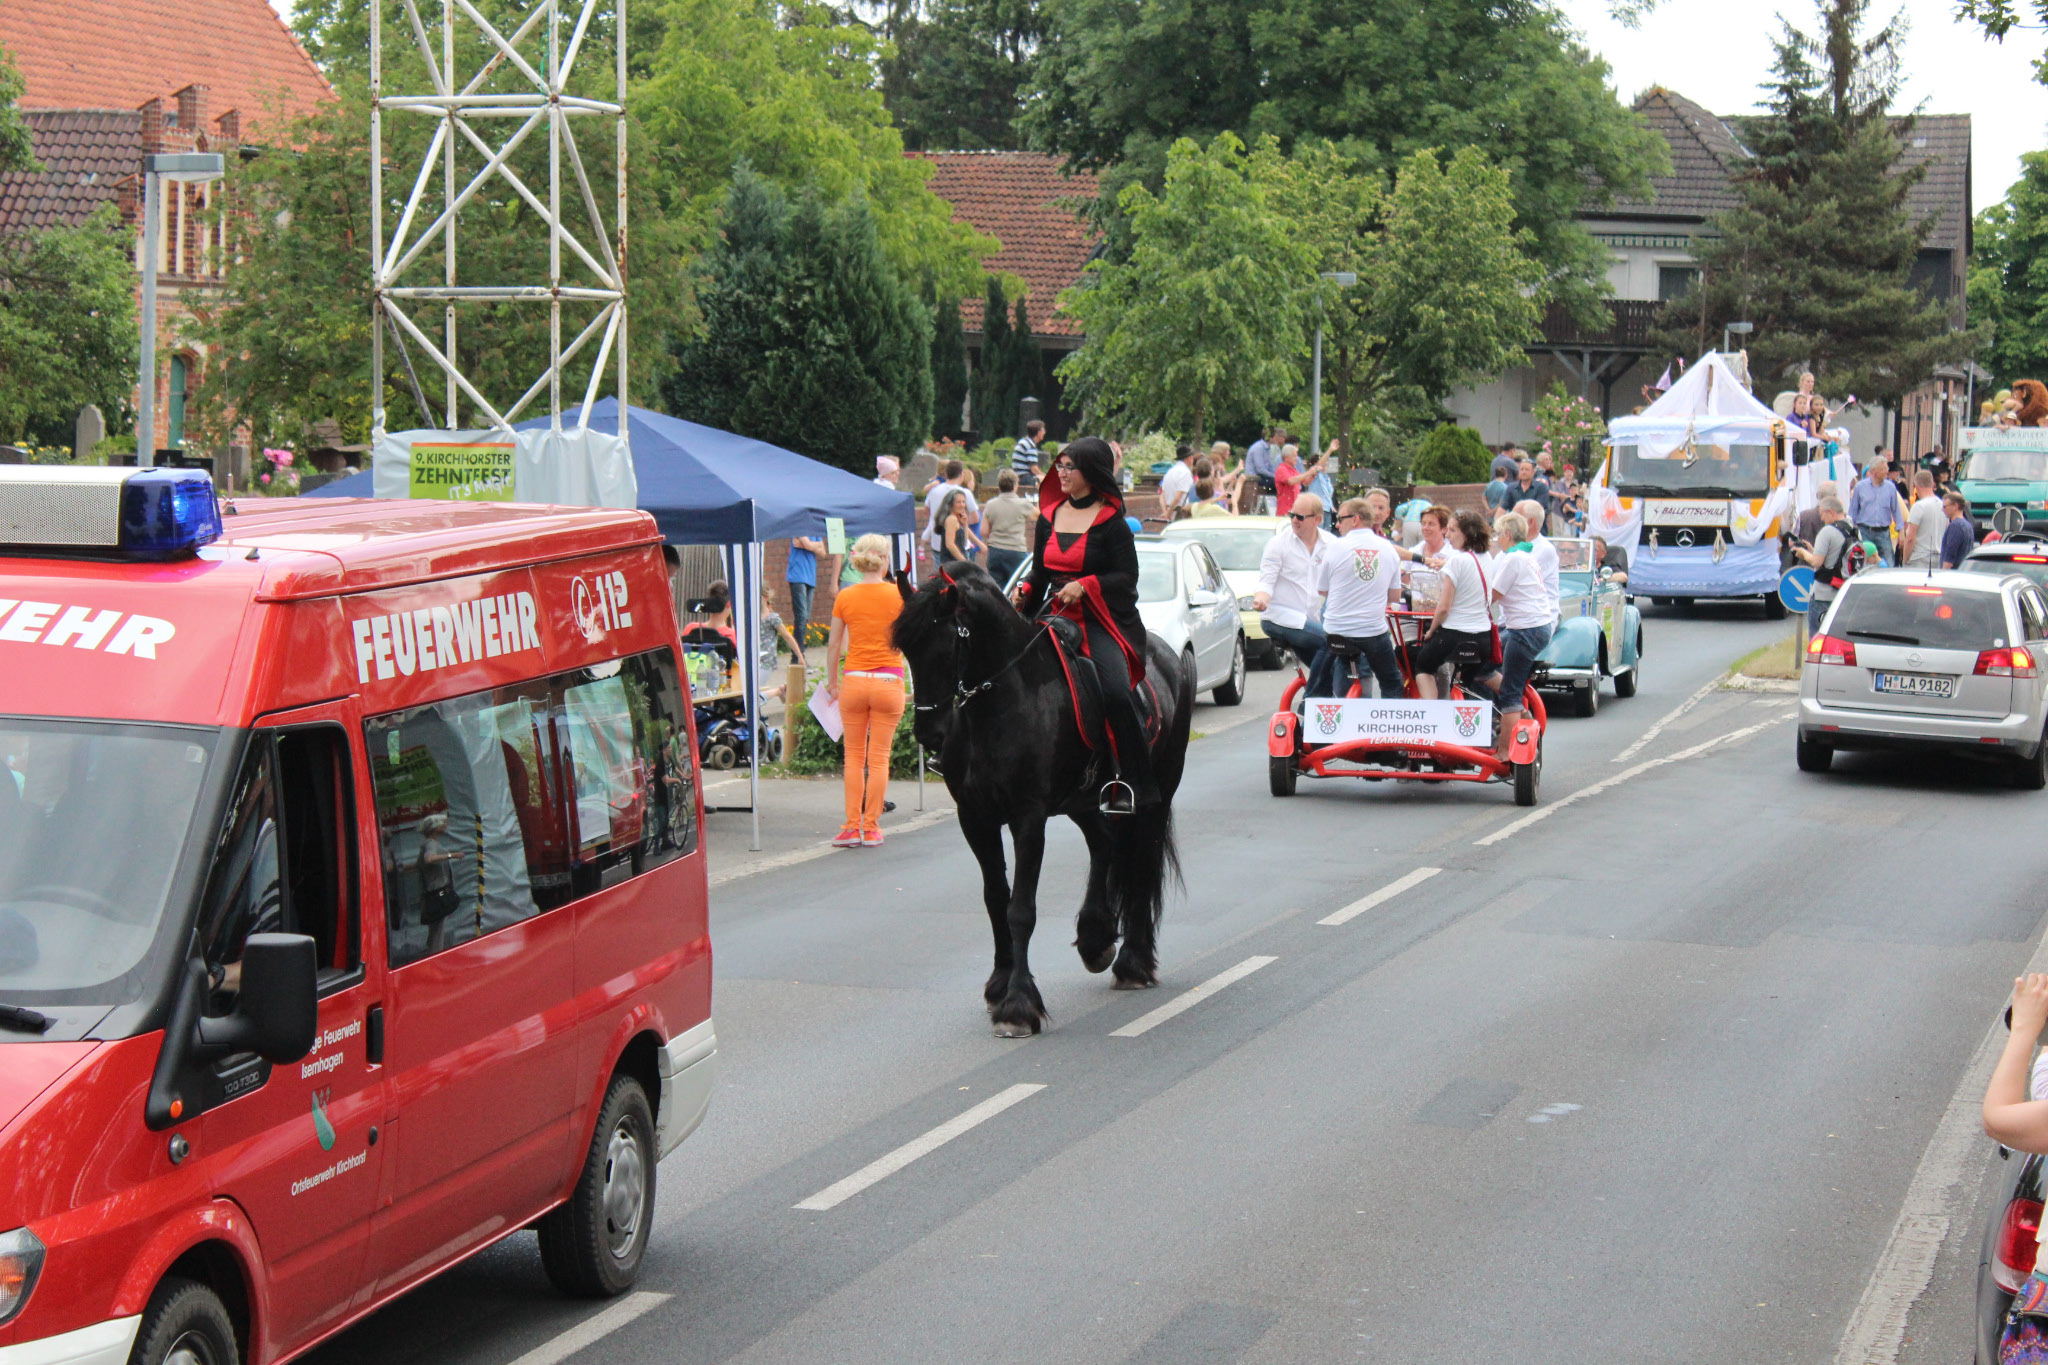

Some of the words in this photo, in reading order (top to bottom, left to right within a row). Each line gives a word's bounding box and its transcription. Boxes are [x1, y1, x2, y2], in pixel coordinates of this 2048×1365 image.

[415, 453, 425, 465] 9.
[427, 453, 511, 465] KIRCHHORSTER
[415, 467, 511, 484] ZEHNTFEST
[1661, 507, 1726, 516] BALLETTSCHULE
[595, 570, 632, 632] 112
[352, 591, 540, 684] FEUERWEHR
[1883, 676, 1893, 688] H
[1899, 678, 1916, 690] LA
[1919, 678, 1950, 693] 9182
[1370, 709, 1427, 720] ORTSRAT
[1357, 723, 1438, 734] KIRCHHORST
[323, 1019, 362, 1047] Feuerwehr
[301, 1051, 343, 1080] Isernhagen
[291, 1165, 336, 1197] Ortsfeuerwehr
[336, 1148, 367, 1176] Kirchhorst
